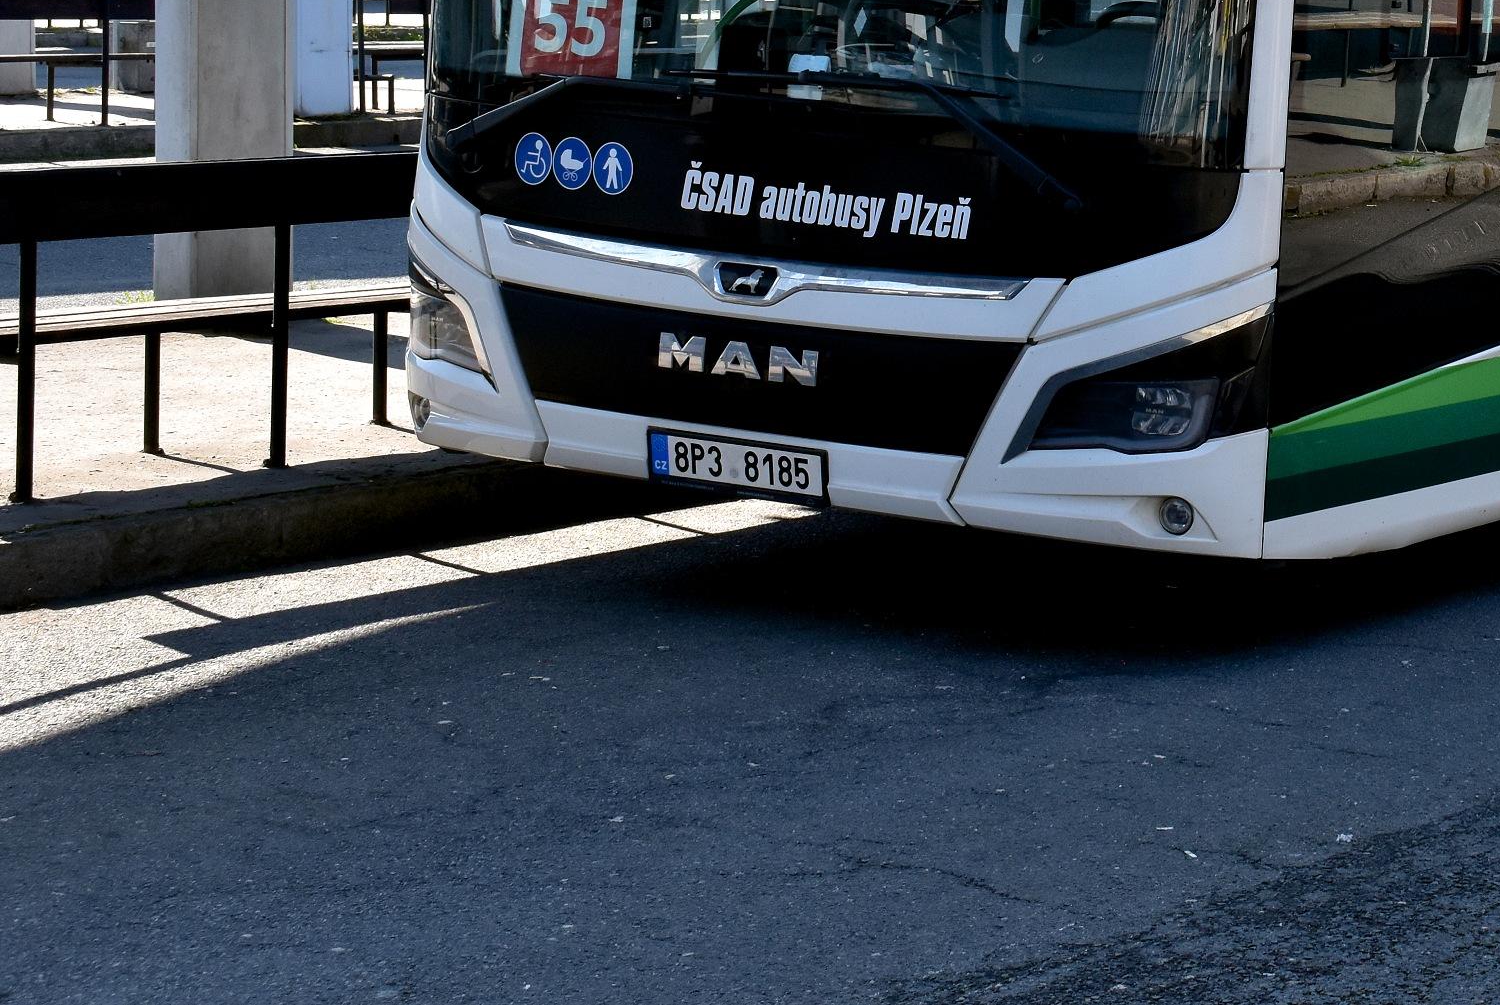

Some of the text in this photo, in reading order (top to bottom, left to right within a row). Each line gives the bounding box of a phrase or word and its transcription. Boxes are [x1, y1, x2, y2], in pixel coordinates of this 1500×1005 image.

[680, 160, 972, 240] ČSAD autobusy Plzeň
[658, 331, 819, 387] MAN
[654, 441, 810, 490] CZ 8P3 8185
